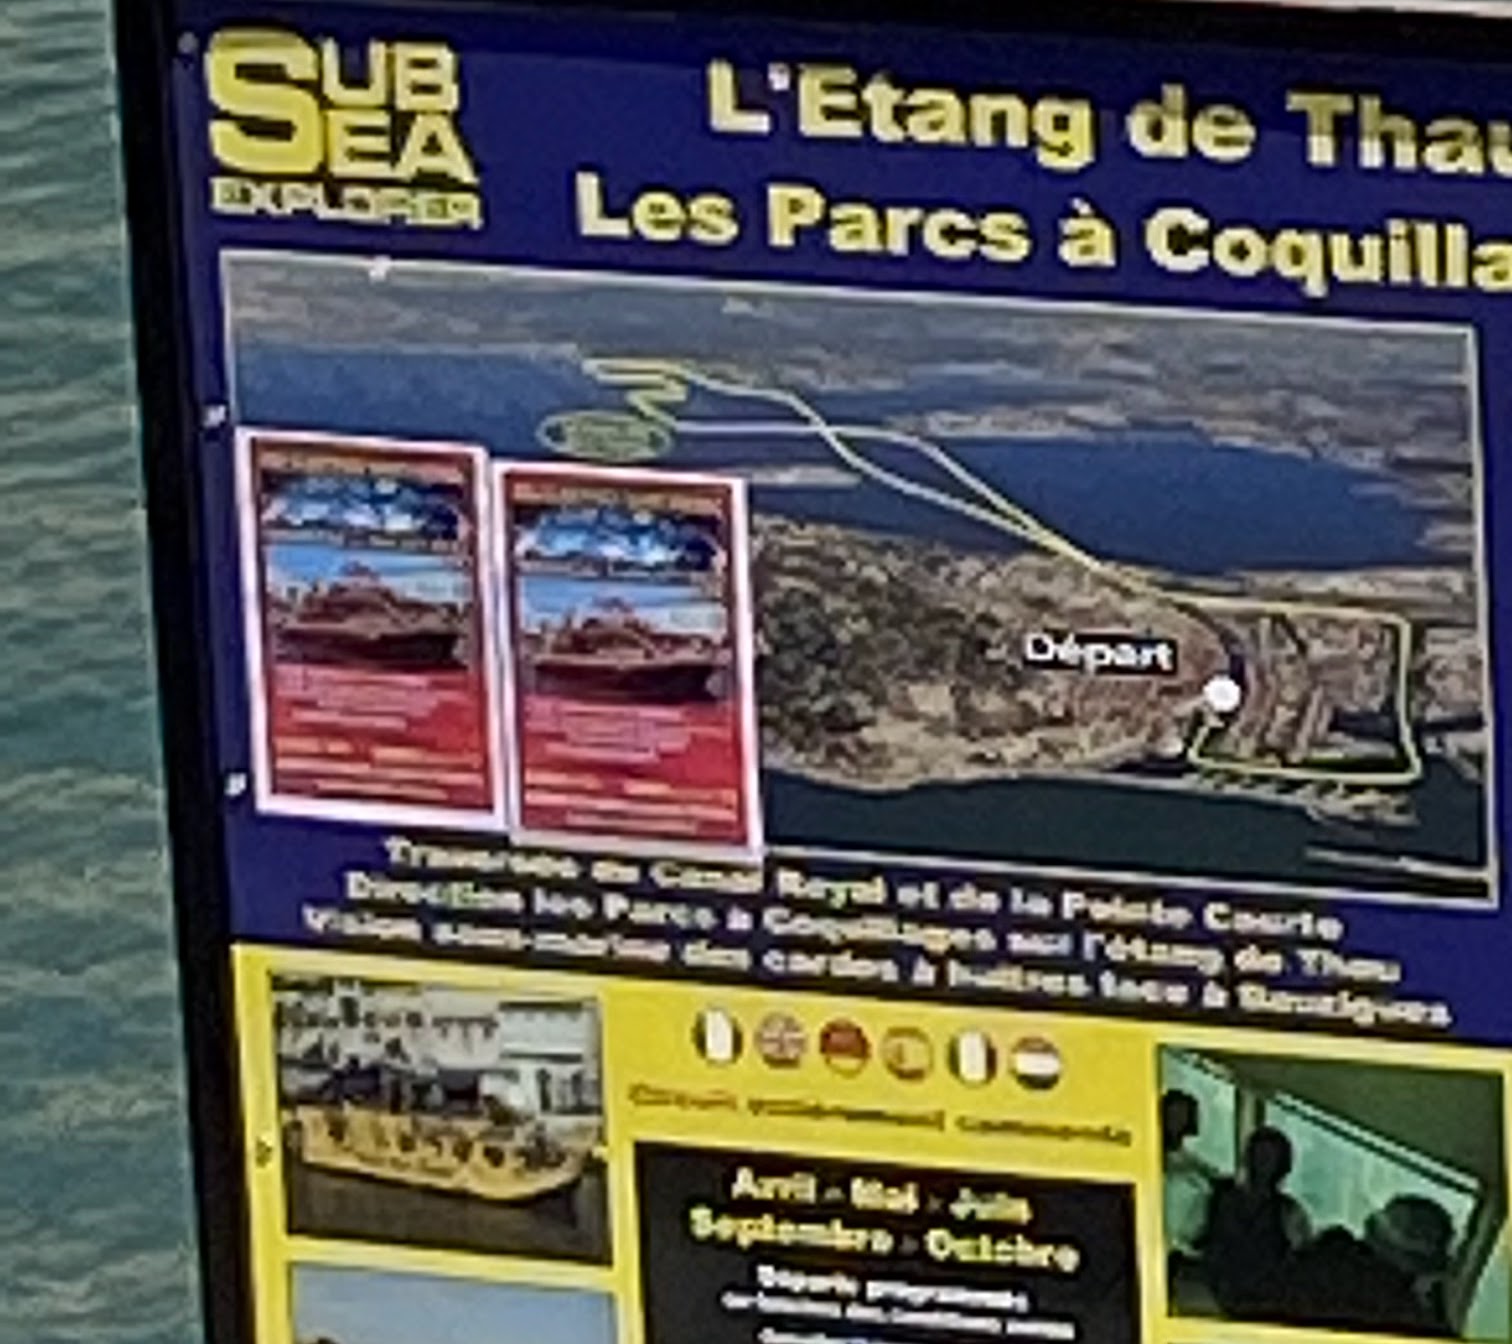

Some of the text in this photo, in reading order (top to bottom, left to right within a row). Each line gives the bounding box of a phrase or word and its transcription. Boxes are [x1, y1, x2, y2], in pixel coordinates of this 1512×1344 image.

[708, 59, 1096, 171] L'Etang
[1125, 83, 1257, 160] de
[208, 174, 484, 229] EXPLORER
[575, 169, 741, 244] Les
[768, 182, 1032, 263] Parcs
[1057, 198, 1117, 269] à
[1024, 632, 1174, 674] Départ
[776, 869, 885, 908] Royal
